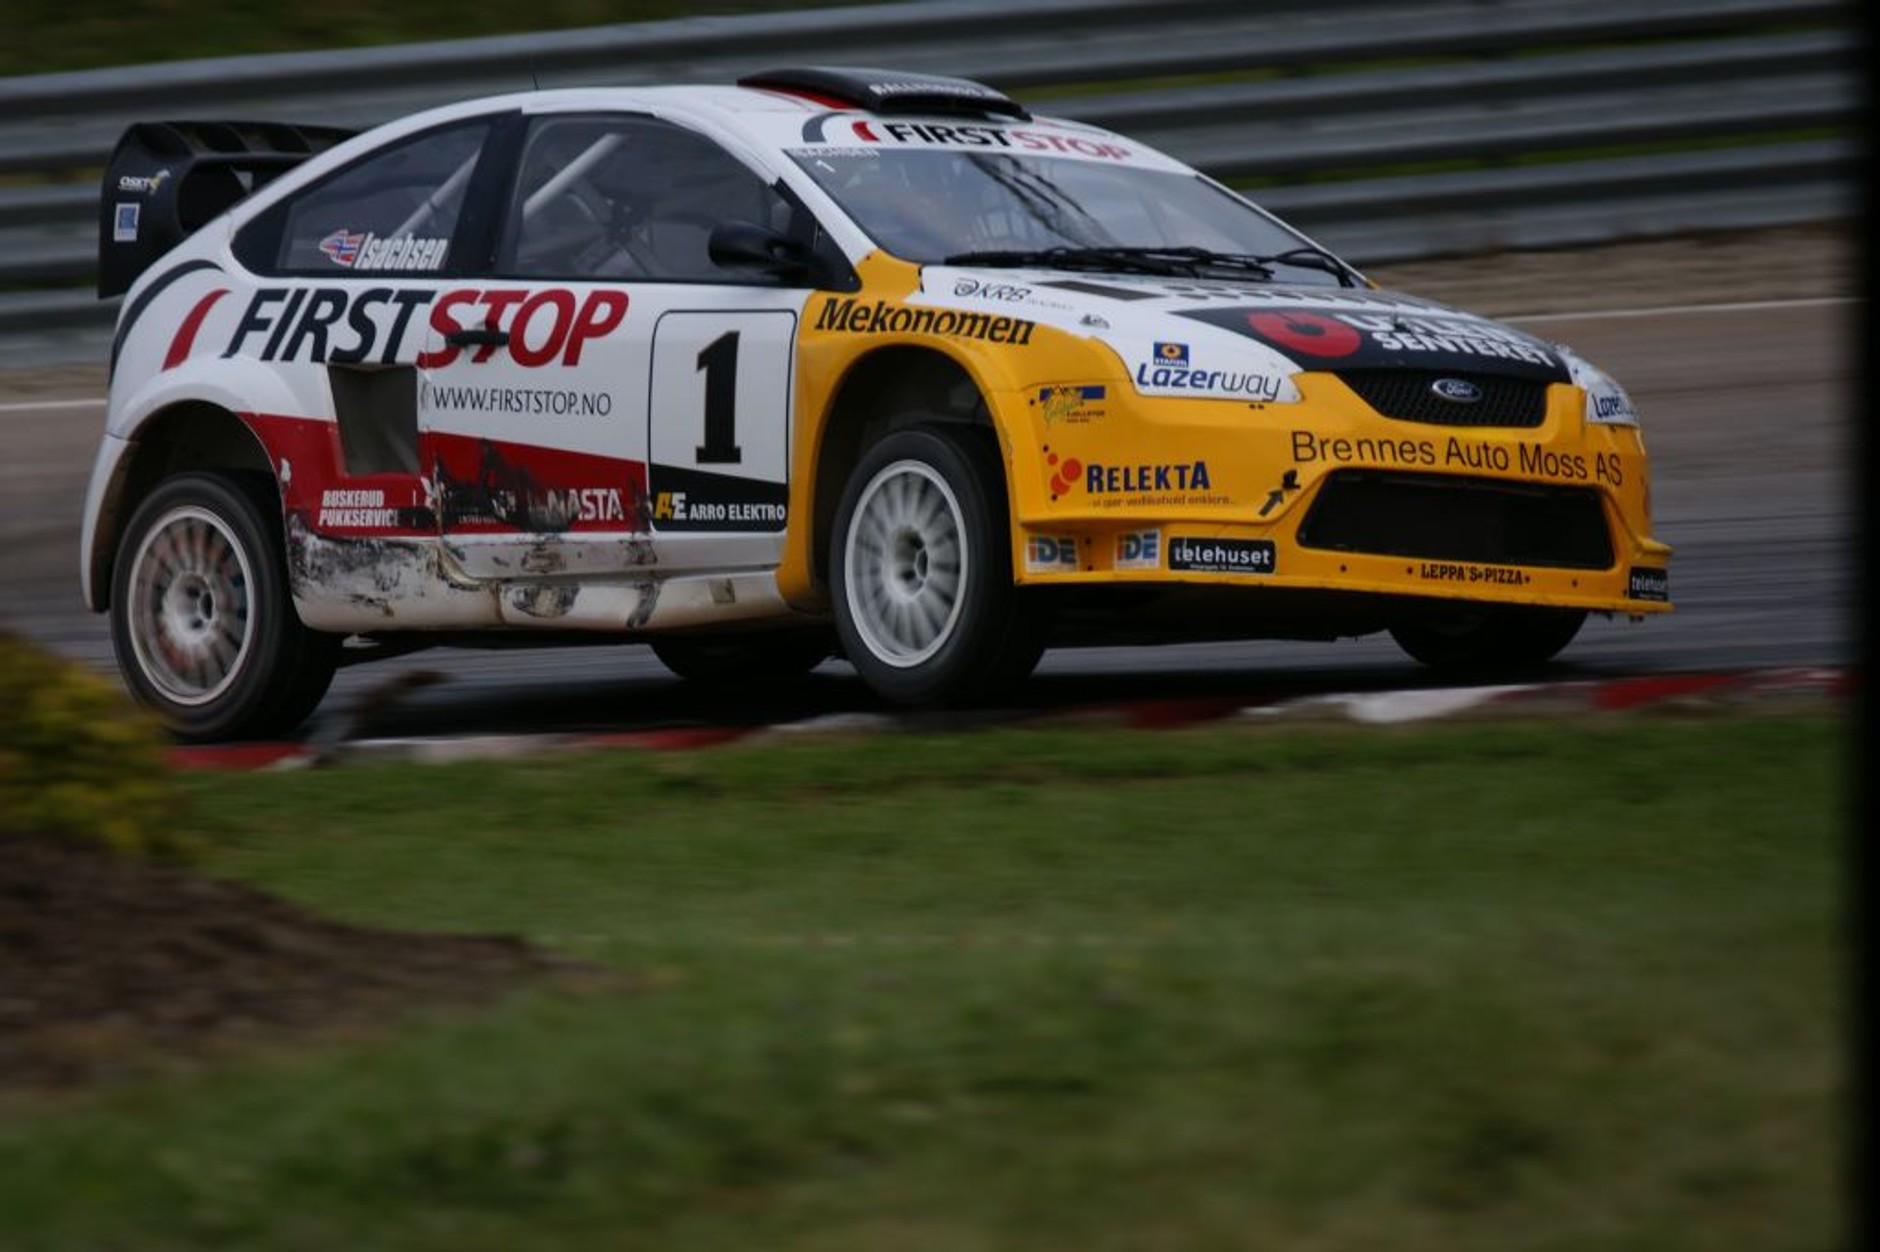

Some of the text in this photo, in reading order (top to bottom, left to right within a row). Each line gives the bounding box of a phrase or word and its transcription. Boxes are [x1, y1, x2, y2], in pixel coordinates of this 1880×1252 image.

[883, 121, 1131, 160] FIRSTSTOP
[354, 232, 448, 270] Isachsen
[220, 287, 630, 368] FIRSTSTOP
[814, 298, 1036, 346] Mekonomen
[1372, 332, 1555, 368] SENTERET
[432, 386, 612, 416] WWW.FIRSTSTOP.NO
[696, 330, 742, 464] 1
[1136, 362, 1281, 403] Lazerway
[1087, 461, 1210, 493] RELEKTA
[1291, 430, 1623, 487] Brennes Auto Moss AS
[689, 504, 726, 520] ARRO
[728, 504, 786, 520] ELEKTRO
[1174, 546, 1270, 565] telehuset
[1484, 566, 1523, 586] PIZZA
